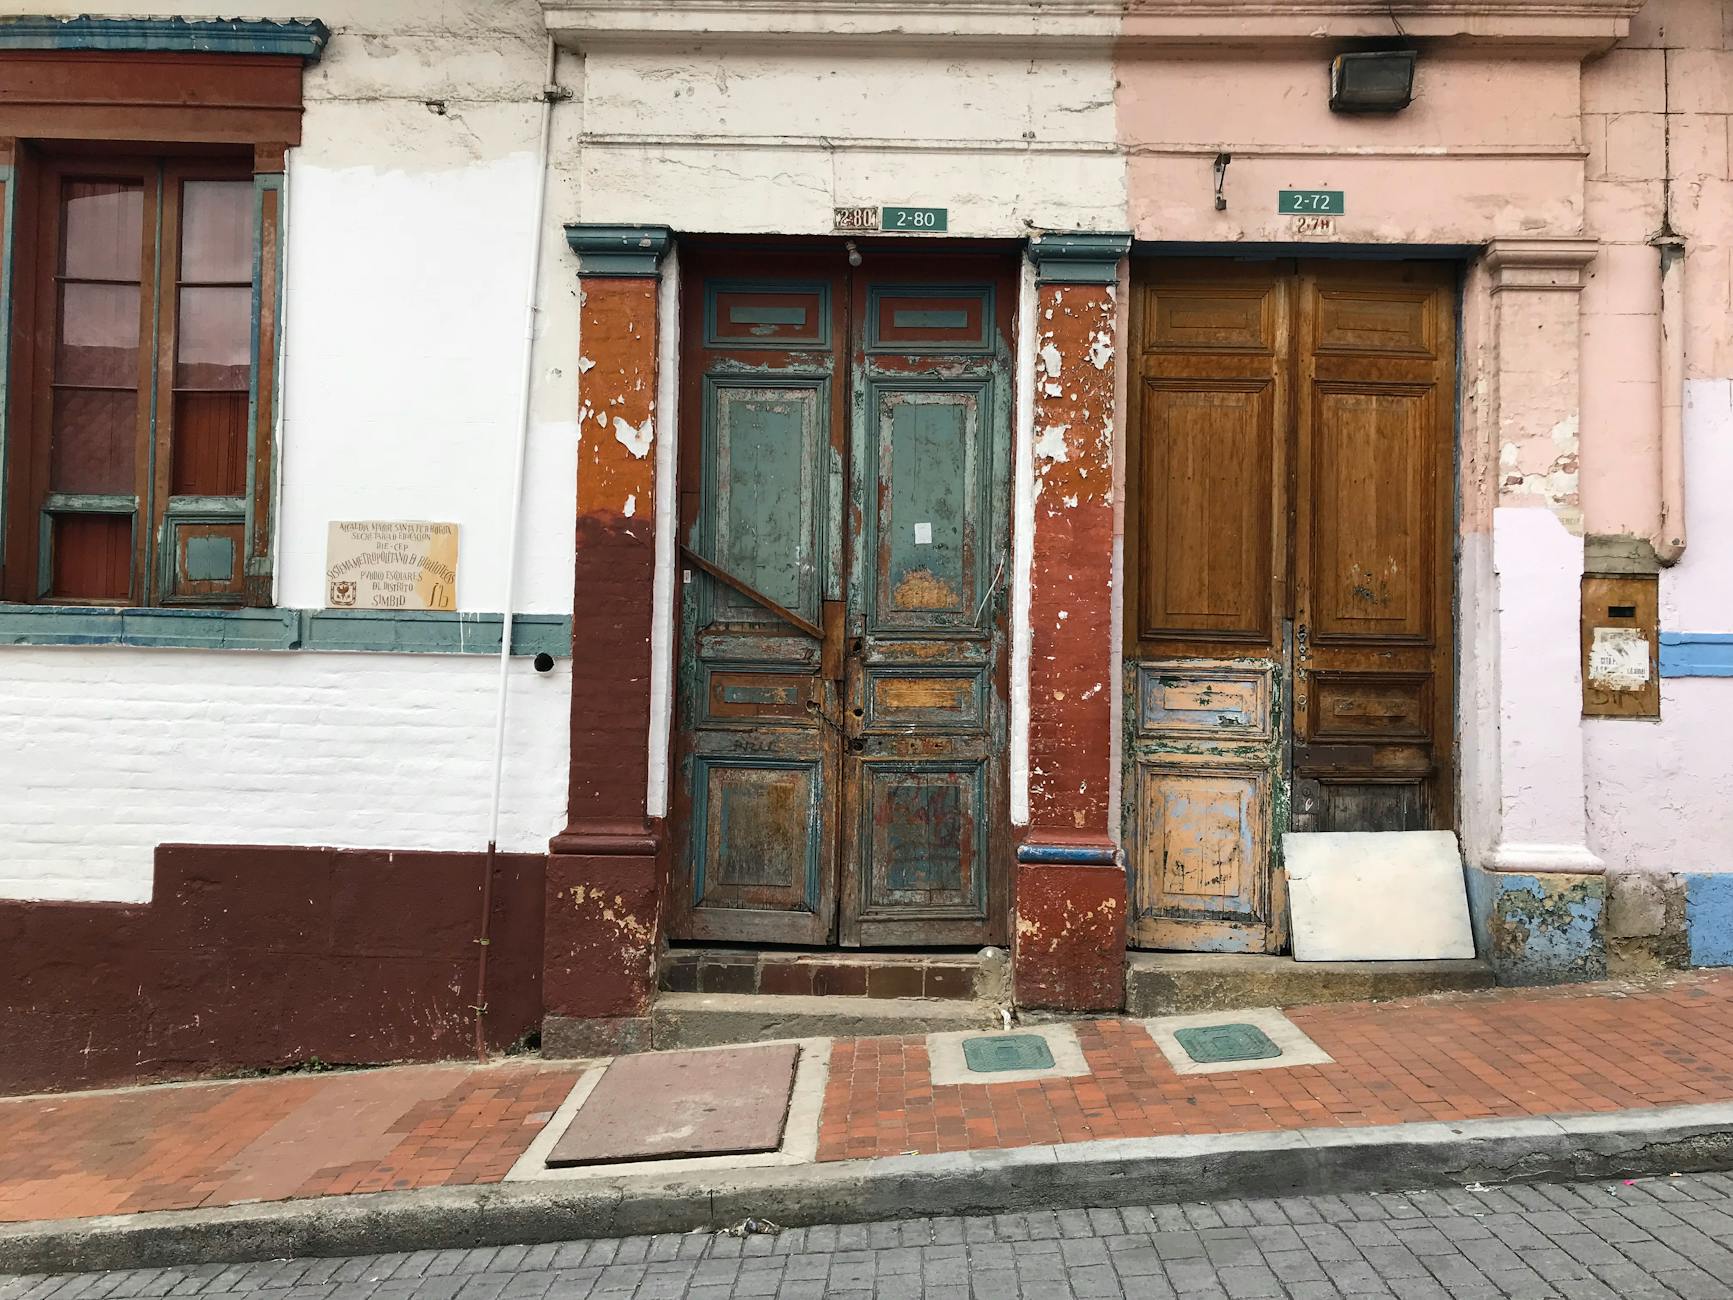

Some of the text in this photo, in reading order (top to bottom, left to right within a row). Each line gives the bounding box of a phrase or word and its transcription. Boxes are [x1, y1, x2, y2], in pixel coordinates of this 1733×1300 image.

[1293, 194, 1330, 210] 2-72
[839, 209, 872, 227] 2-80
[896, 211, 935, 227] 2-80
[372, 593, 406, 608] SIMBID
